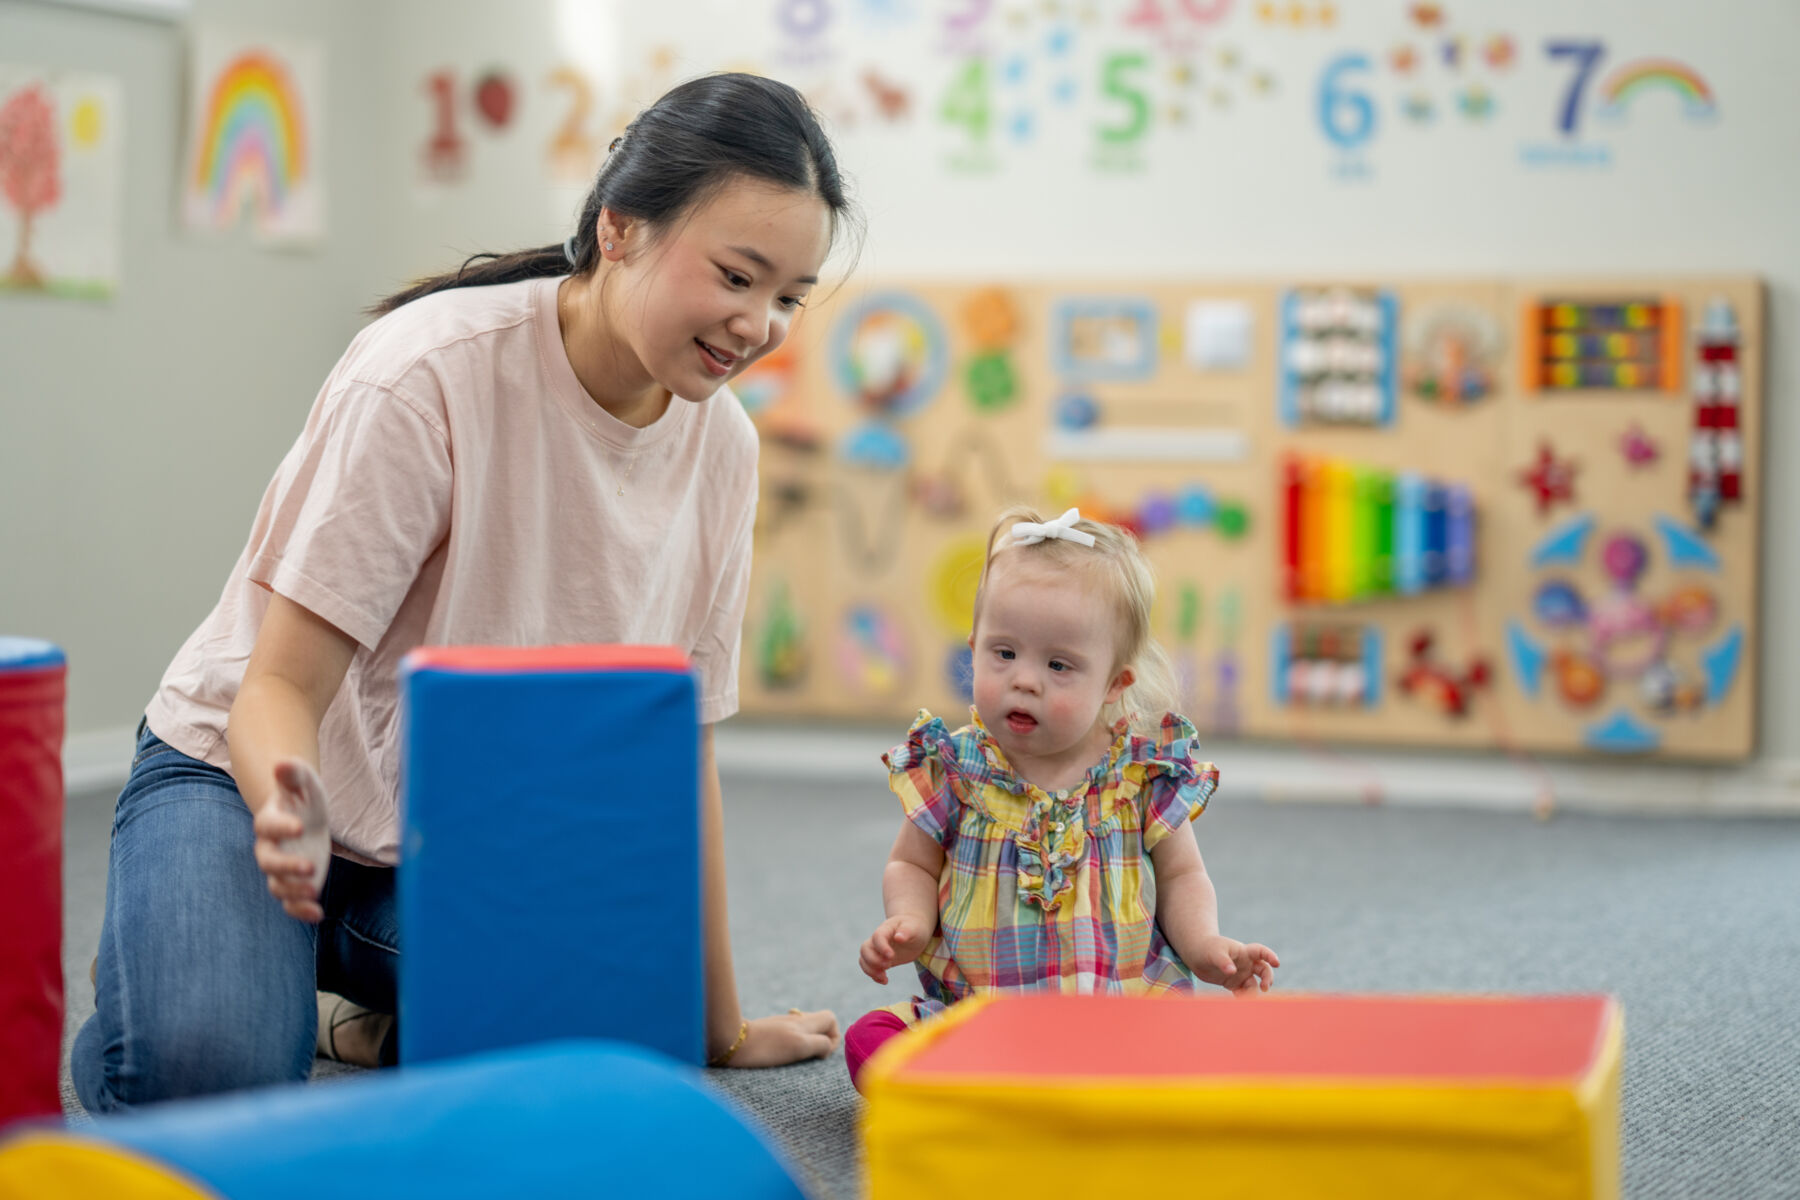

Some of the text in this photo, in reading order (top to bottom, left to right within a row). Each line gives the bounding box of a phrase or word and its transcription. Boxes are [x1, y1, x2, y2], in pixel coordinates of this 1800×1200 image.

[939, 57, 992, 143] 4
[1098, 52, 1155, 145] 5
[1317, 54, 1376, 149] 6
[1546, 41, 1608, 134] 7
